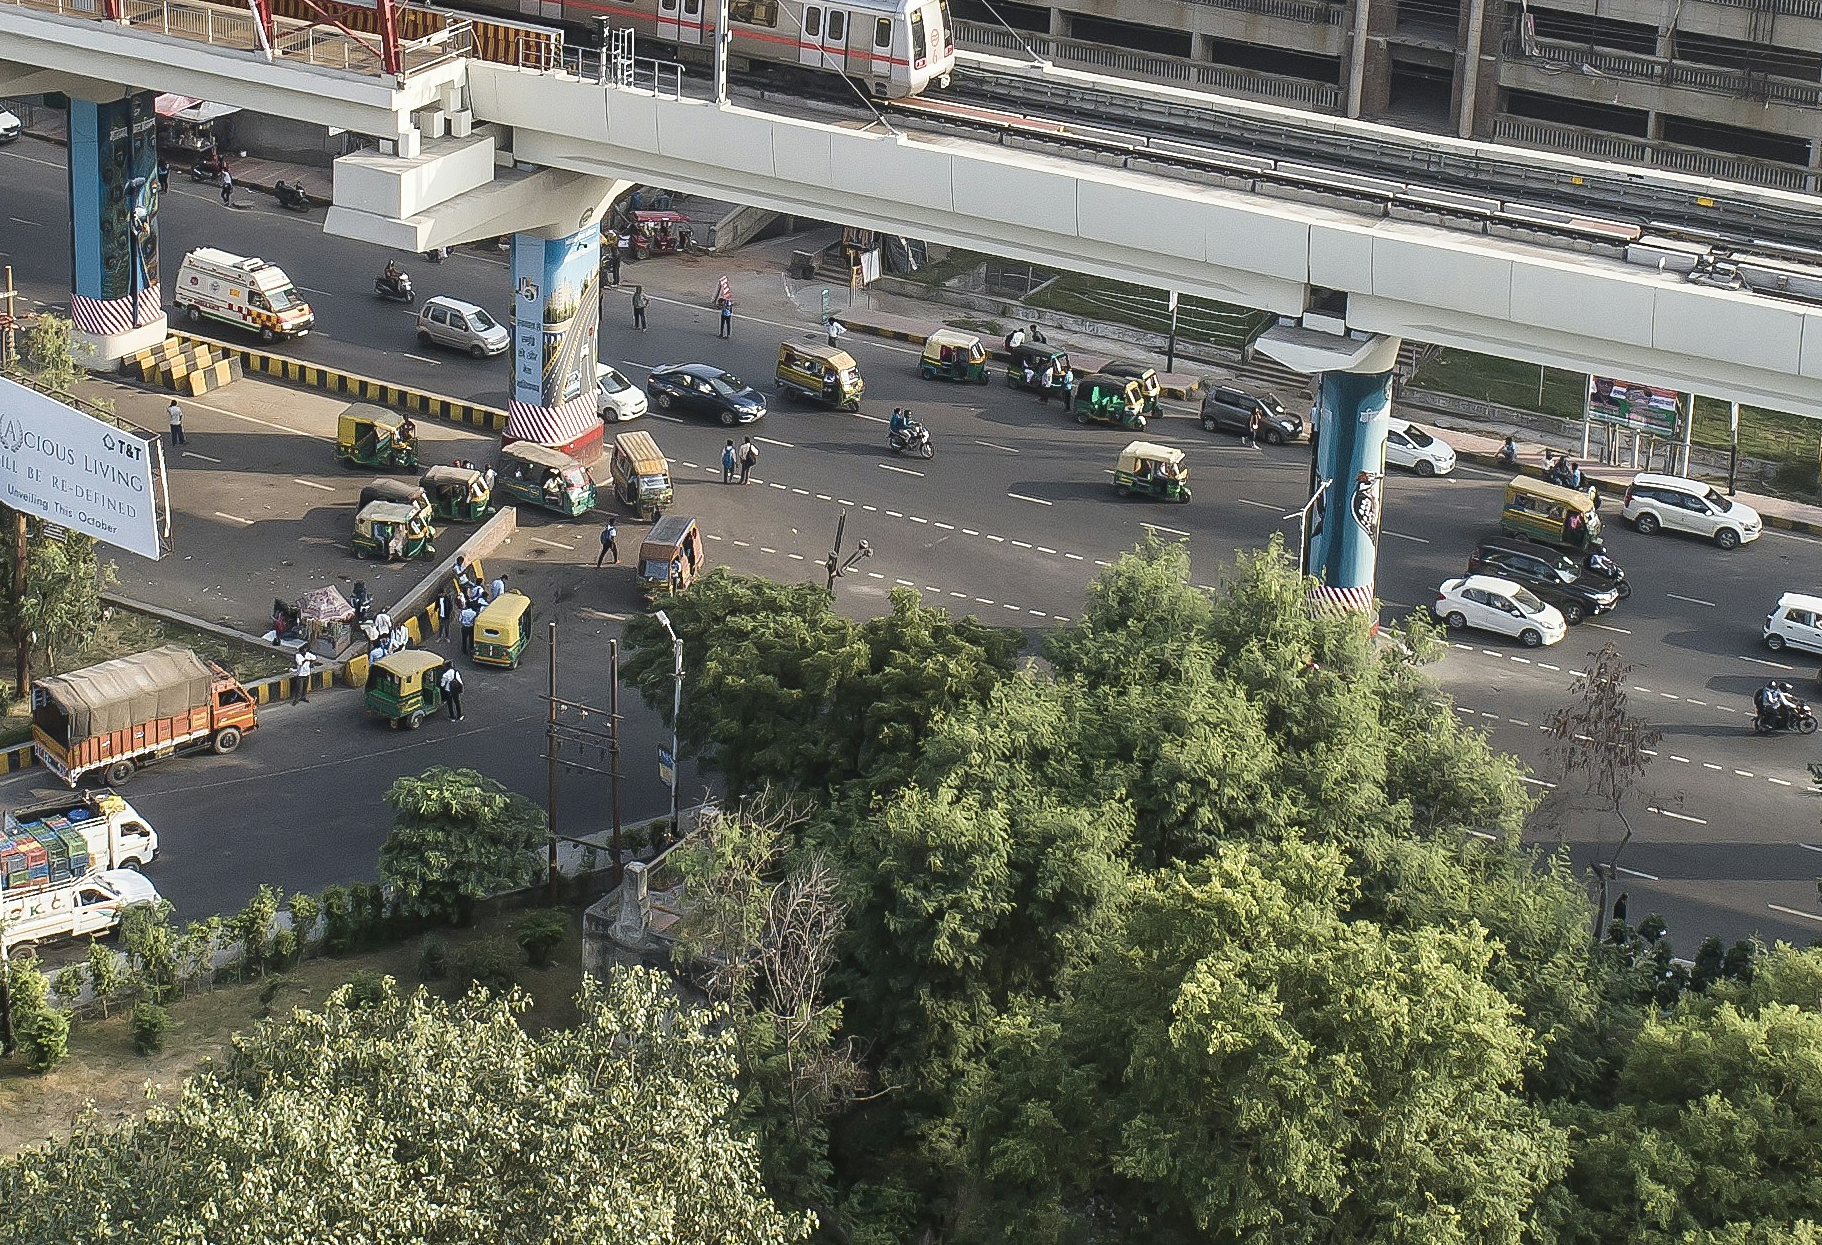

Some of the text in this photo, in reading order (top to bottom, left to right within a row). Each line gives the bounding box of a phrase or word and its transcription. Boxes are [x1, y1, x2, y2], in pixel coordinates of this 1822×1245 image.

[117, 439, 143, 461] T&T
[27, 466, 42, 483] BE
[52, 475, 137, 518] RE-DEFINED
[84, 455, 143, 492] LIVING
[7, 483, 49, 511] Unveiling
[54, 501, 73, 518] This
[78, 511, 118, 534] October
